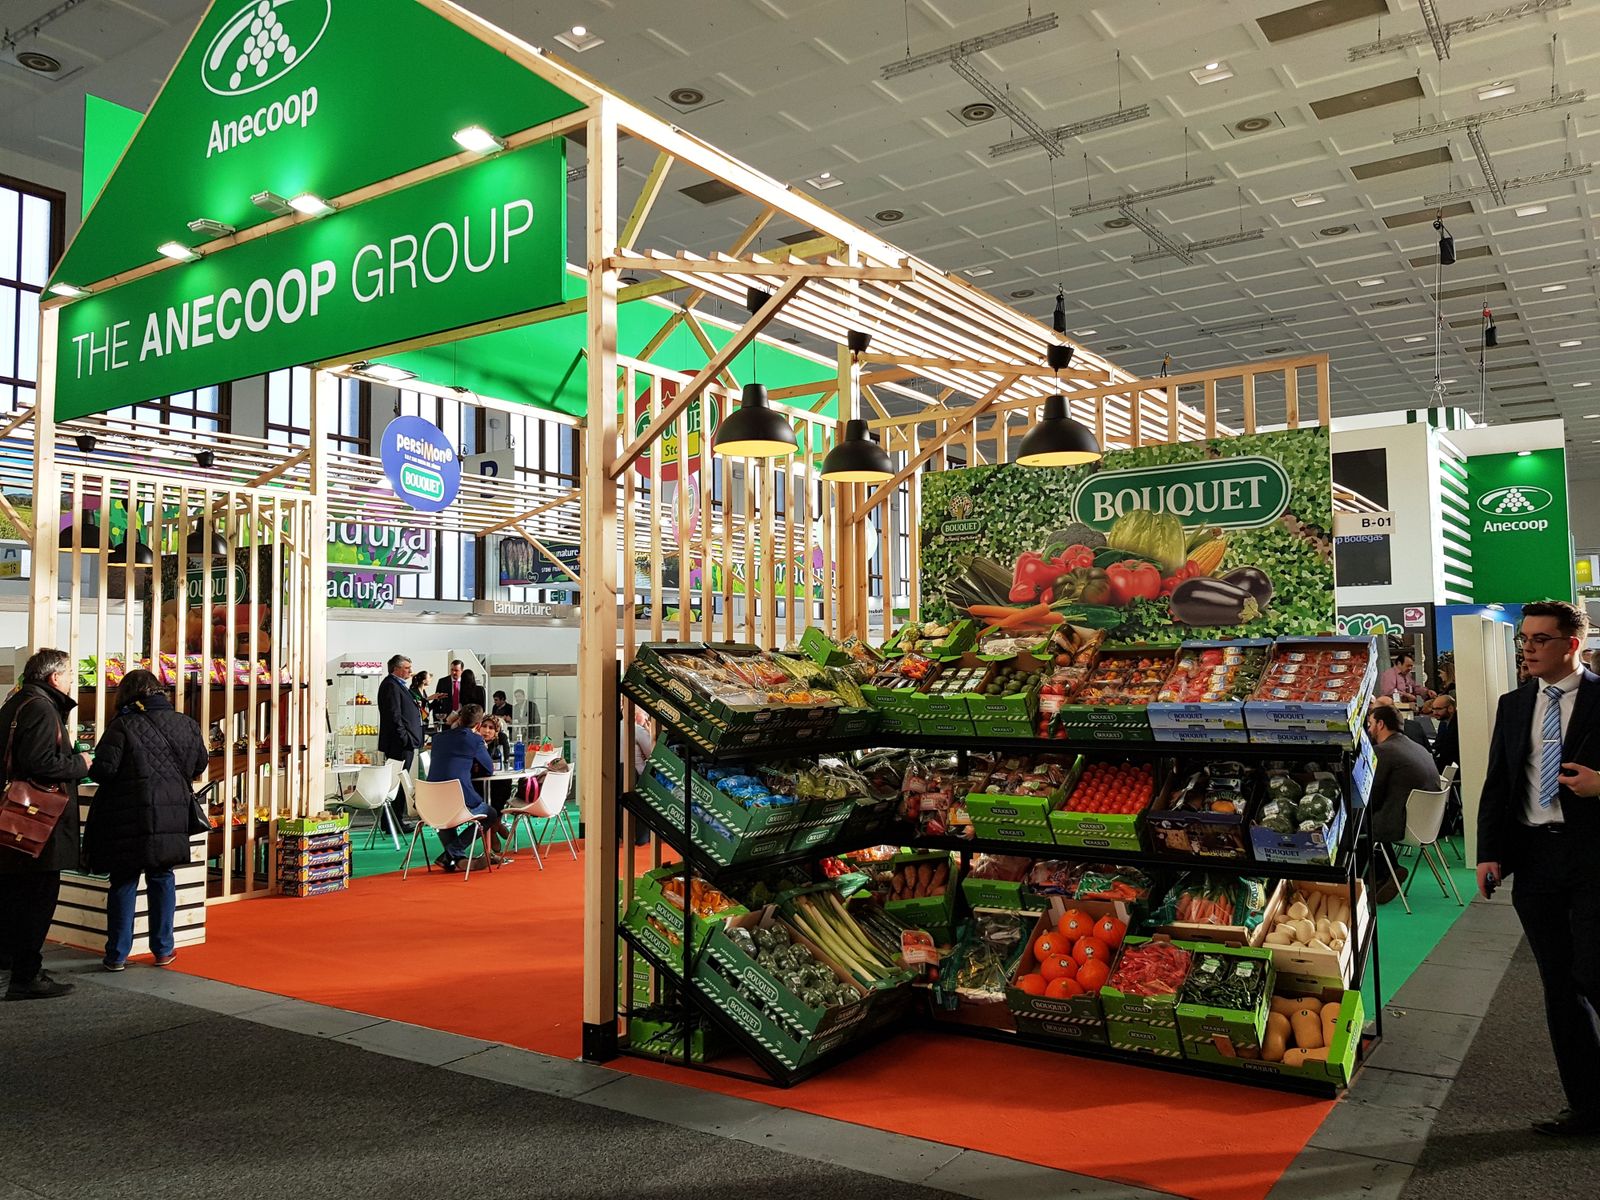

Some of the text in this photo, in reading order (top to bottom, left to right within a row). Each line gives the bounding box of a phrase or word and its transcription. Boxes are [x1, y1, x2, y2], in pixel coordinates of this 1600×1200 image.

[206, 86, 318, 158] Anecoop
[72, 198, 535, 379] THE ANECOOP GROUP
[405, 471, 441, 494] BOUQUET
[1092, 475, 1268, 522] BOUQUET
[945, 522, 978, 533] BOUQUET
[1361, 517, 1392, 528] B-01
[1483, 518, 1549, 533] Anecoop
[656, 904, 683, 929] BOUQUET
[643, 928, 670, 954] BOUQUET
[746, 970, 776, 999] BOUQUET
[730, 1000, 759, 1029] BOUQUET
